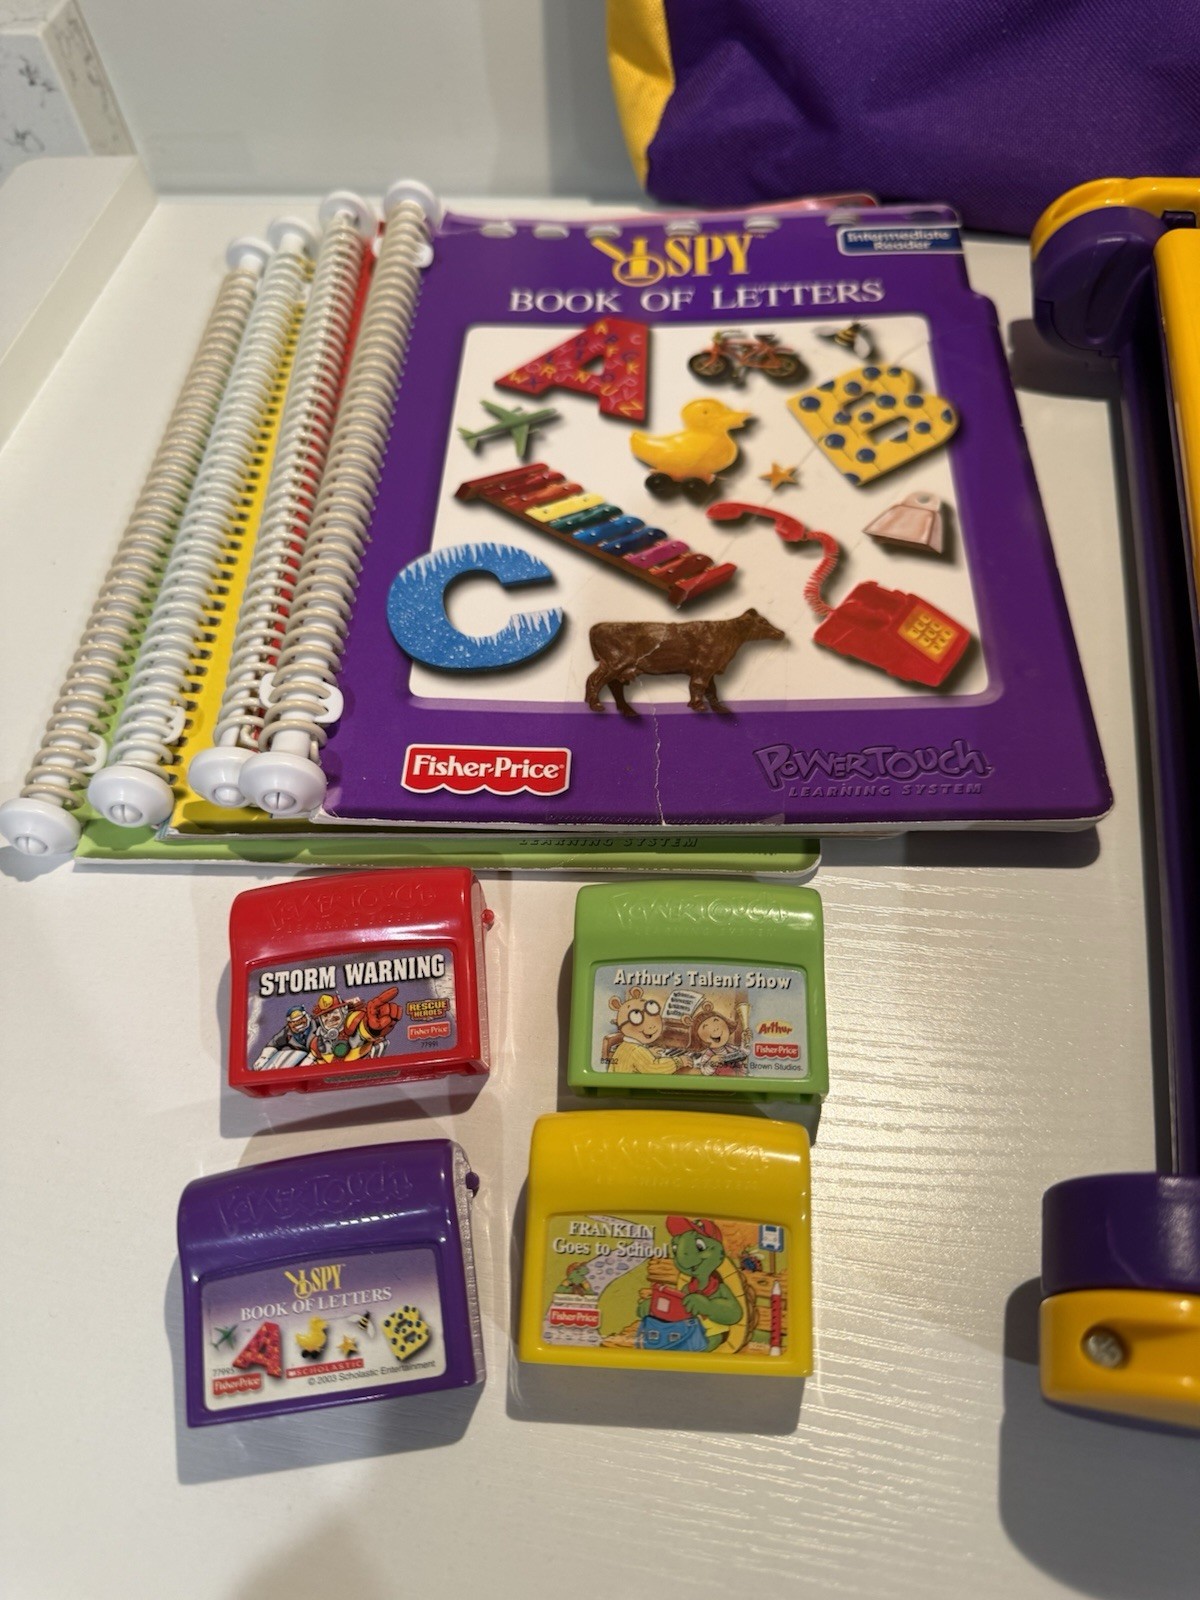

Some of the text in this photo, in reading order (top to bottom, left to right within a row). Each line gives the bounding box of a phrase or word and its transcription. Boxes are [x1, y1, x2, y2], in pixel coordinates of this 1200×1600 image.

[846, 229, 951, 242] Intermediate
[873, 240, 930, 251] Reader
[664, 233, 752, 278] SPY
[508, 278, 886, 313] BOOK OF LETTERS
[411, 753, 564, 780] Fisher-Price
[789, 783, 983, 798] LEARNING SYSTEM
[260, 953, 446, 997] STORM WARNING
[614, 968, 792, 990] Arthur's Talent Show
[409, 1000, 447, 1011] RESCUE
[413, 1009, 443, 1018] HEROES
[758, 1021, 793, 1035] Arthur
[756, 1045, 798, 1055] Fisher-Price
[750, 1062, 773, 1070] Brown
[569, 1221, 656, 1240] FRANKLIN
[552, 1237, 669, 1259] Goes to School
[311, 1264, 342, 1293] SPY
[241, 1286, 392, 1322] BOOK OF LETTERS
[552, 1310, 599, 1322] Fisher-Price
[295, 1359, 363, 1376] SCHOLASTIC
[338, 1366, 379, 1382] Scholastic
[380, 1360, 436, 1375] Entertainment
